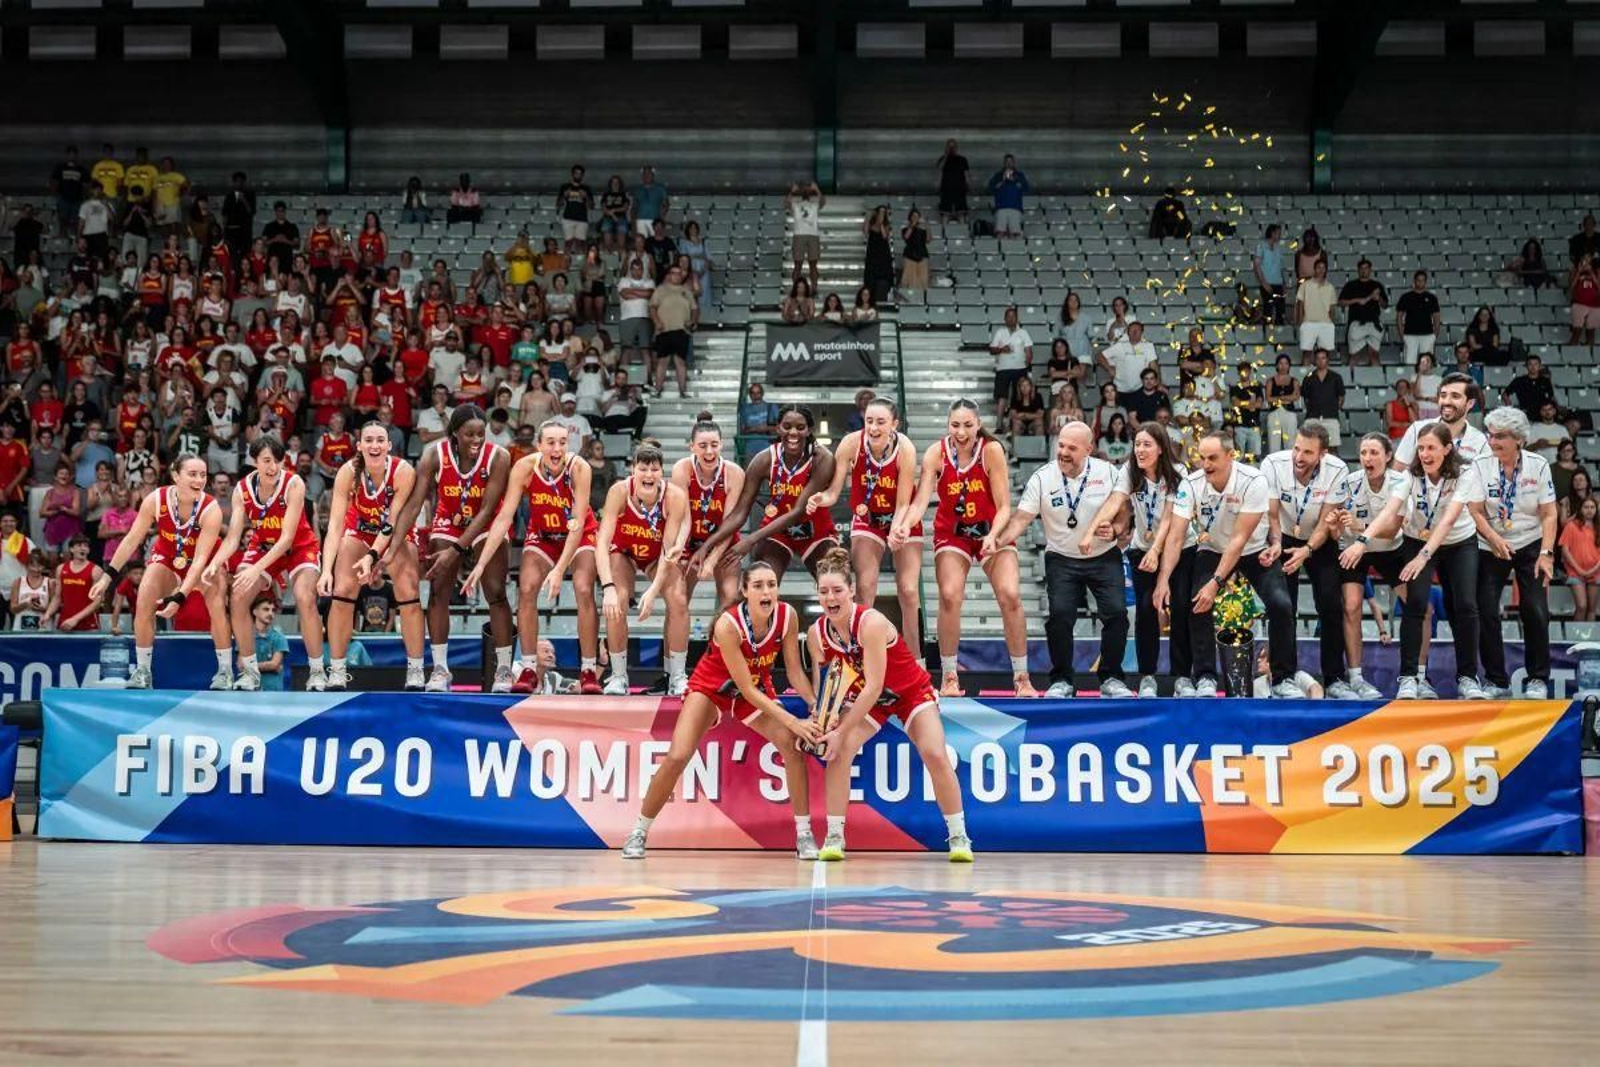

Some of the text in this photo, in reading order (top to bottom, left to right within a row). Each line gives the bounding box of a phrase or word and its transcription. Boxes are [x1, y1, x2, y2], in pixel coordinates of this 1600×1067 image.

[813, 341, 875, 351] matosinhos
[813, 352, 842, 361] sport
[179, 436, 201, 454] 15
[462, 505, 473, 517] 9
[543, 513, 561, 528] 10
[631, 543, 650, 557] 12
[114, 733, 267, 796] FIBA
[300, 736, 433, 798] U20
[464, 737, 791, 802] WOMEN'S
[1320, 743, 1500, 807] 2025
[1053, 920, 1262, 946] 2025
